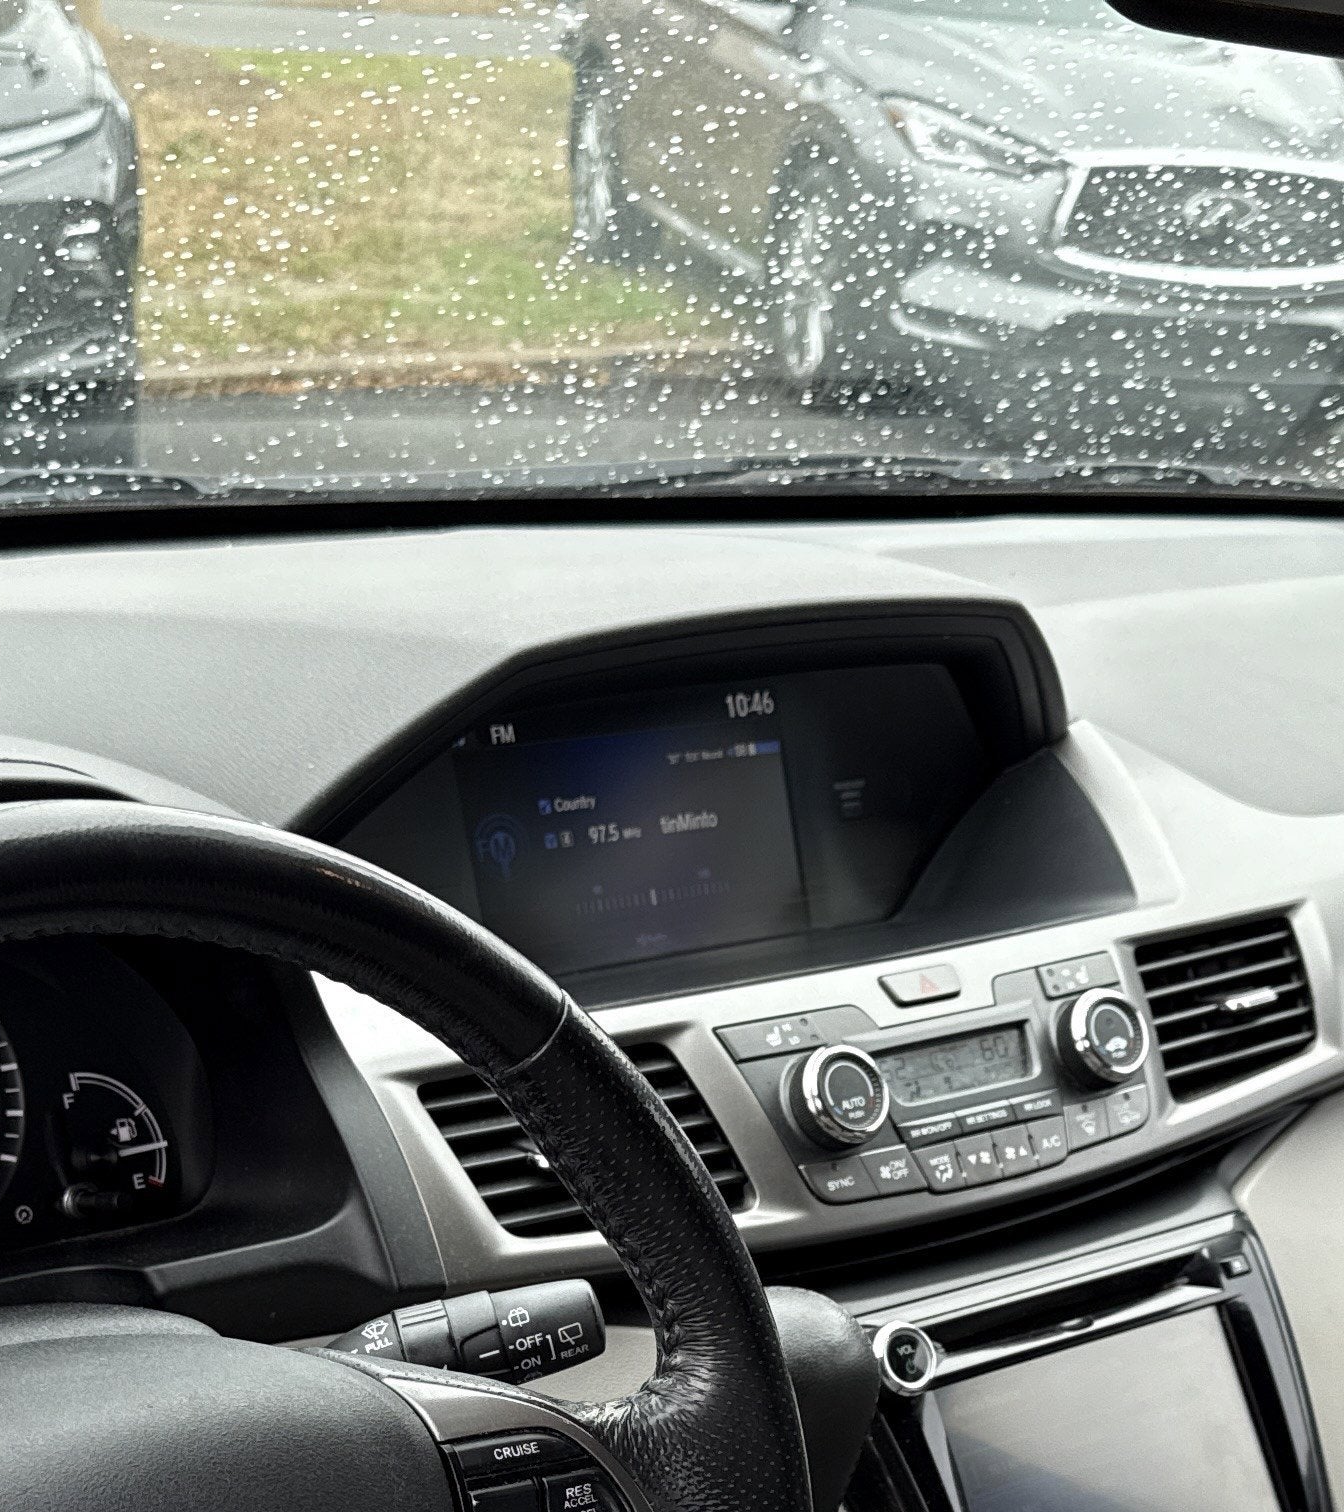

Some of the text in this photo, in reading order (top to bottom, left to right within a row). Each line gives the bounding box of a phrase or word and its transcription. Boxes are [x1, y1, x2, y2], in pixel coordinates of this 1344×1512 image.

[724, 690, 776, 719] 10:46
[489, 723, 516, 745] FM
[553, 795, 596, 813] Country
[587, 822, 620, 843] 97.5
[63, 1093, 75, 1109] F
[841, 1096, 865, 1110] AUTO
[1041, 1135, 1062, 1149] A/C
[133, 1174, 145, 1190] E
[826, 1176, 855, 1191] SYNC
[365, 1336, 393, 1353] PULL
[516, 1332, 544, 1351] OFF
[560, 1343, 590, 1360] REAR
[521, 1355, 542, 1370] ON
[493, 1441, 540, 1461] CRUISE
[566, 1483, 592, 1497] RES
[564, 1495, 598, 1509] ACCEL
